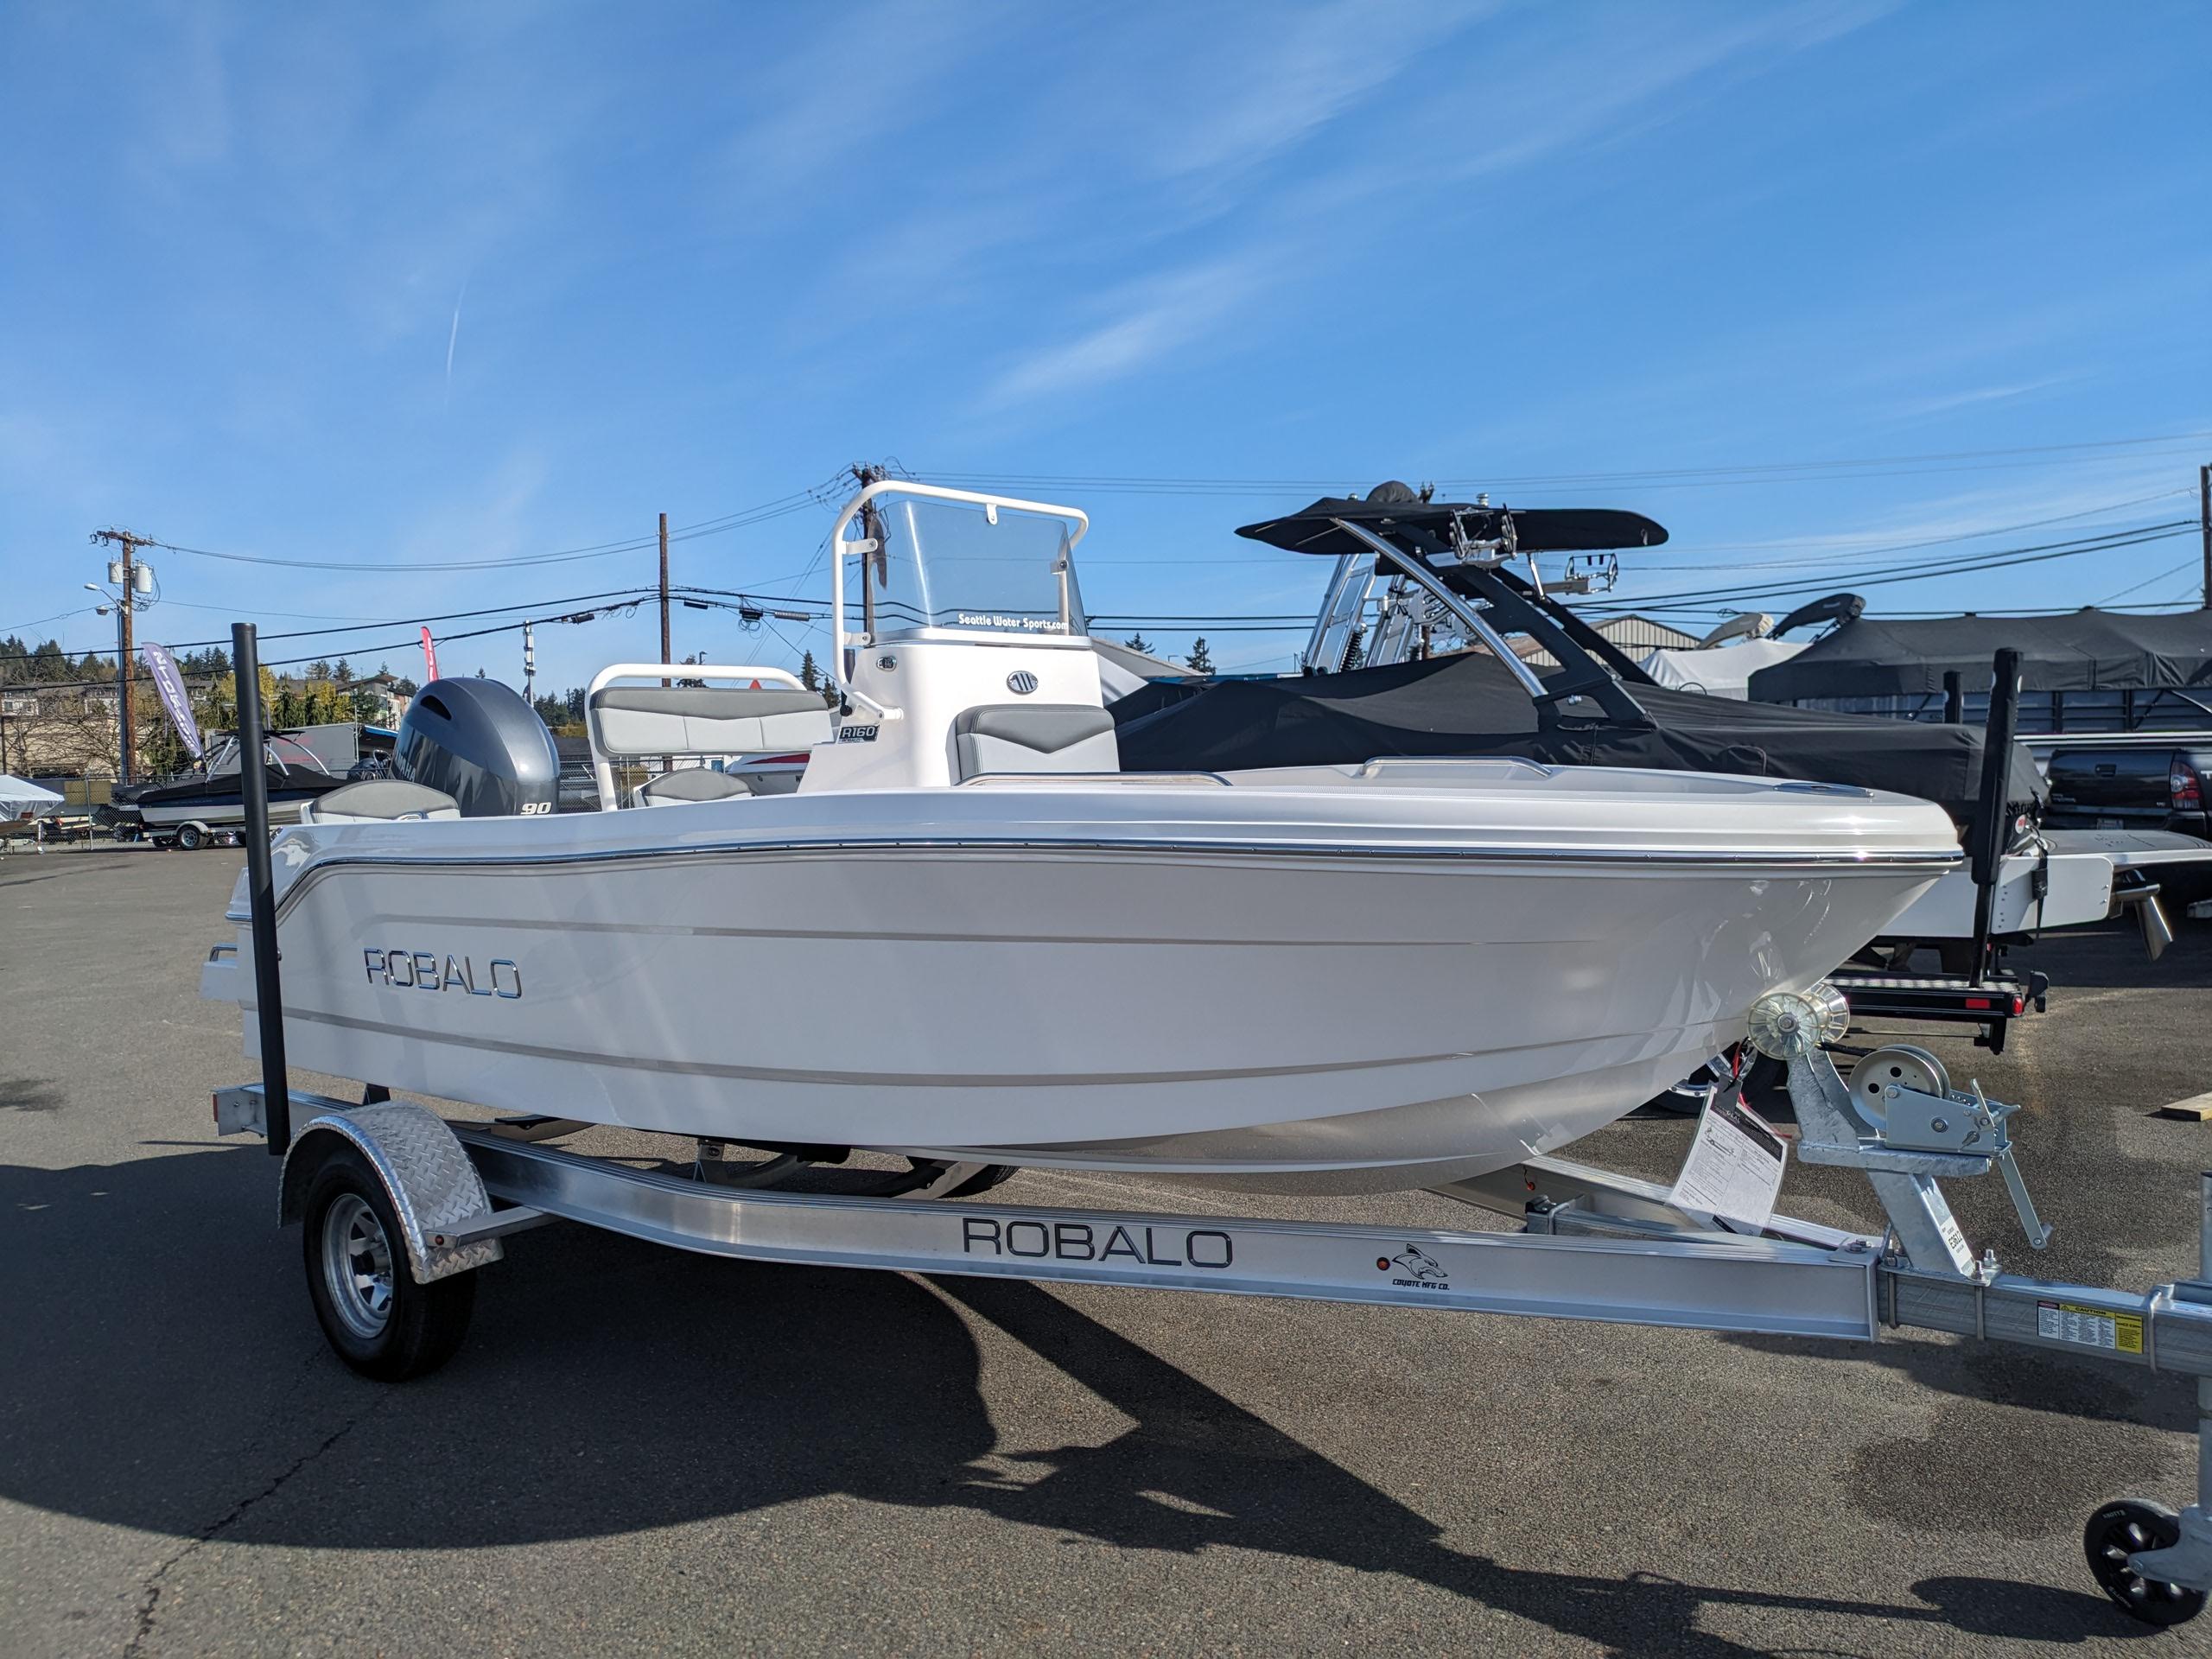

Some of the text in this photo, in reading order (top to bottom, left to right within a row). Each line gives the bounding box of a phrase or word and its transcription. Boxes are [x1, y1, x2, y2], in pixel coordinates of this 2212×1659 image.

[958, 613, 1069, 630] Seattle Water Sports.com
[842, 726, 875, 738] R160
[520, 802, 552, 815] 90
[364, 947, 523, 1000] ROBALO
[962, 1217, 1233, 1268] ROBALO
[1392, 1279, 1421, 1287] COYOTE
[2075, 1306, 2107, 1315] CAUTION
